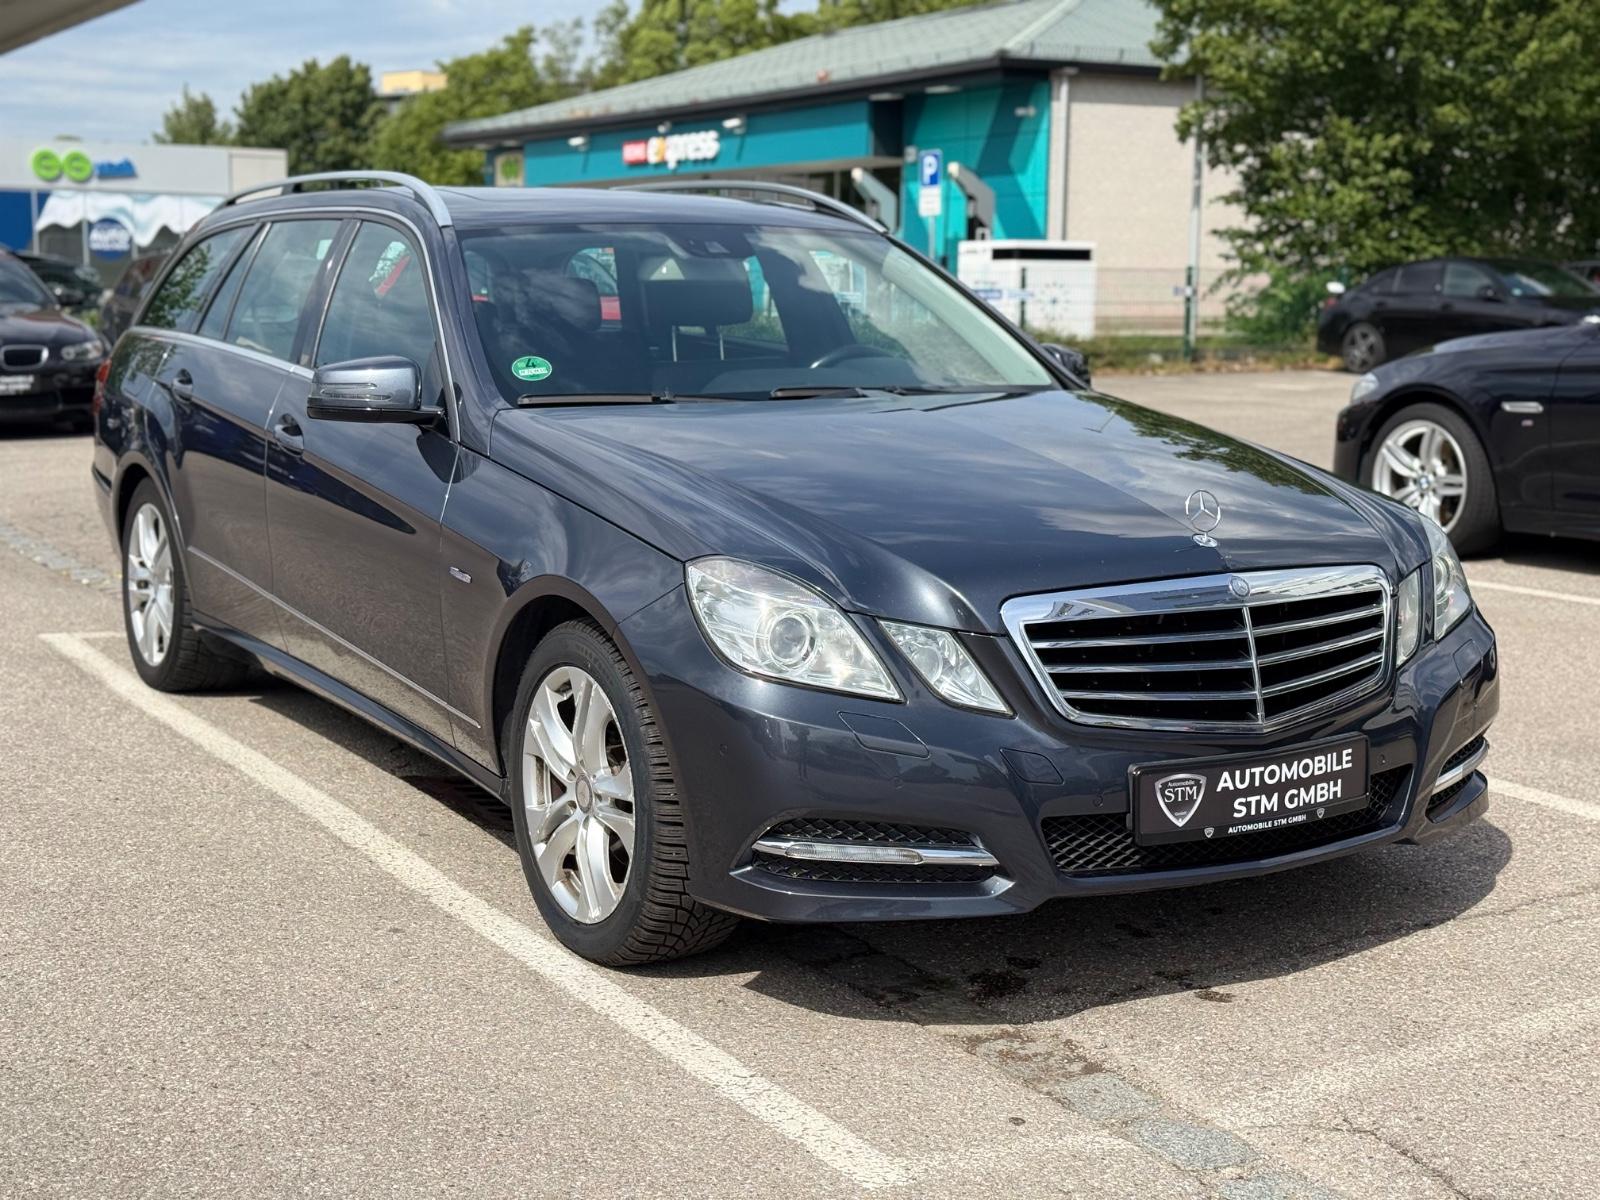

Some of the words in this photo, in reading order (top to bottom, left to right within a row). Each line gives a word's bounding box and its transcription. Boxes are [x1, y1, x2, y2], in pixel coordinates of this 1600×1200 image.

[923, 155, 938, 185] P
[525, 358, 536, 368] 4
[1216, 748, 1353, 792] AUTOMOBILE
[1164, 786, 1198, 803] STM
[1233, 792, 1279, 818] STM
[1284, 779, 1342, 809] GMBH
[1227, 820, 1273, 834] AUTOMOBILE
[1273, 817, 1288, 827] STM
[1287, 814, 1307, 824] GMBH
